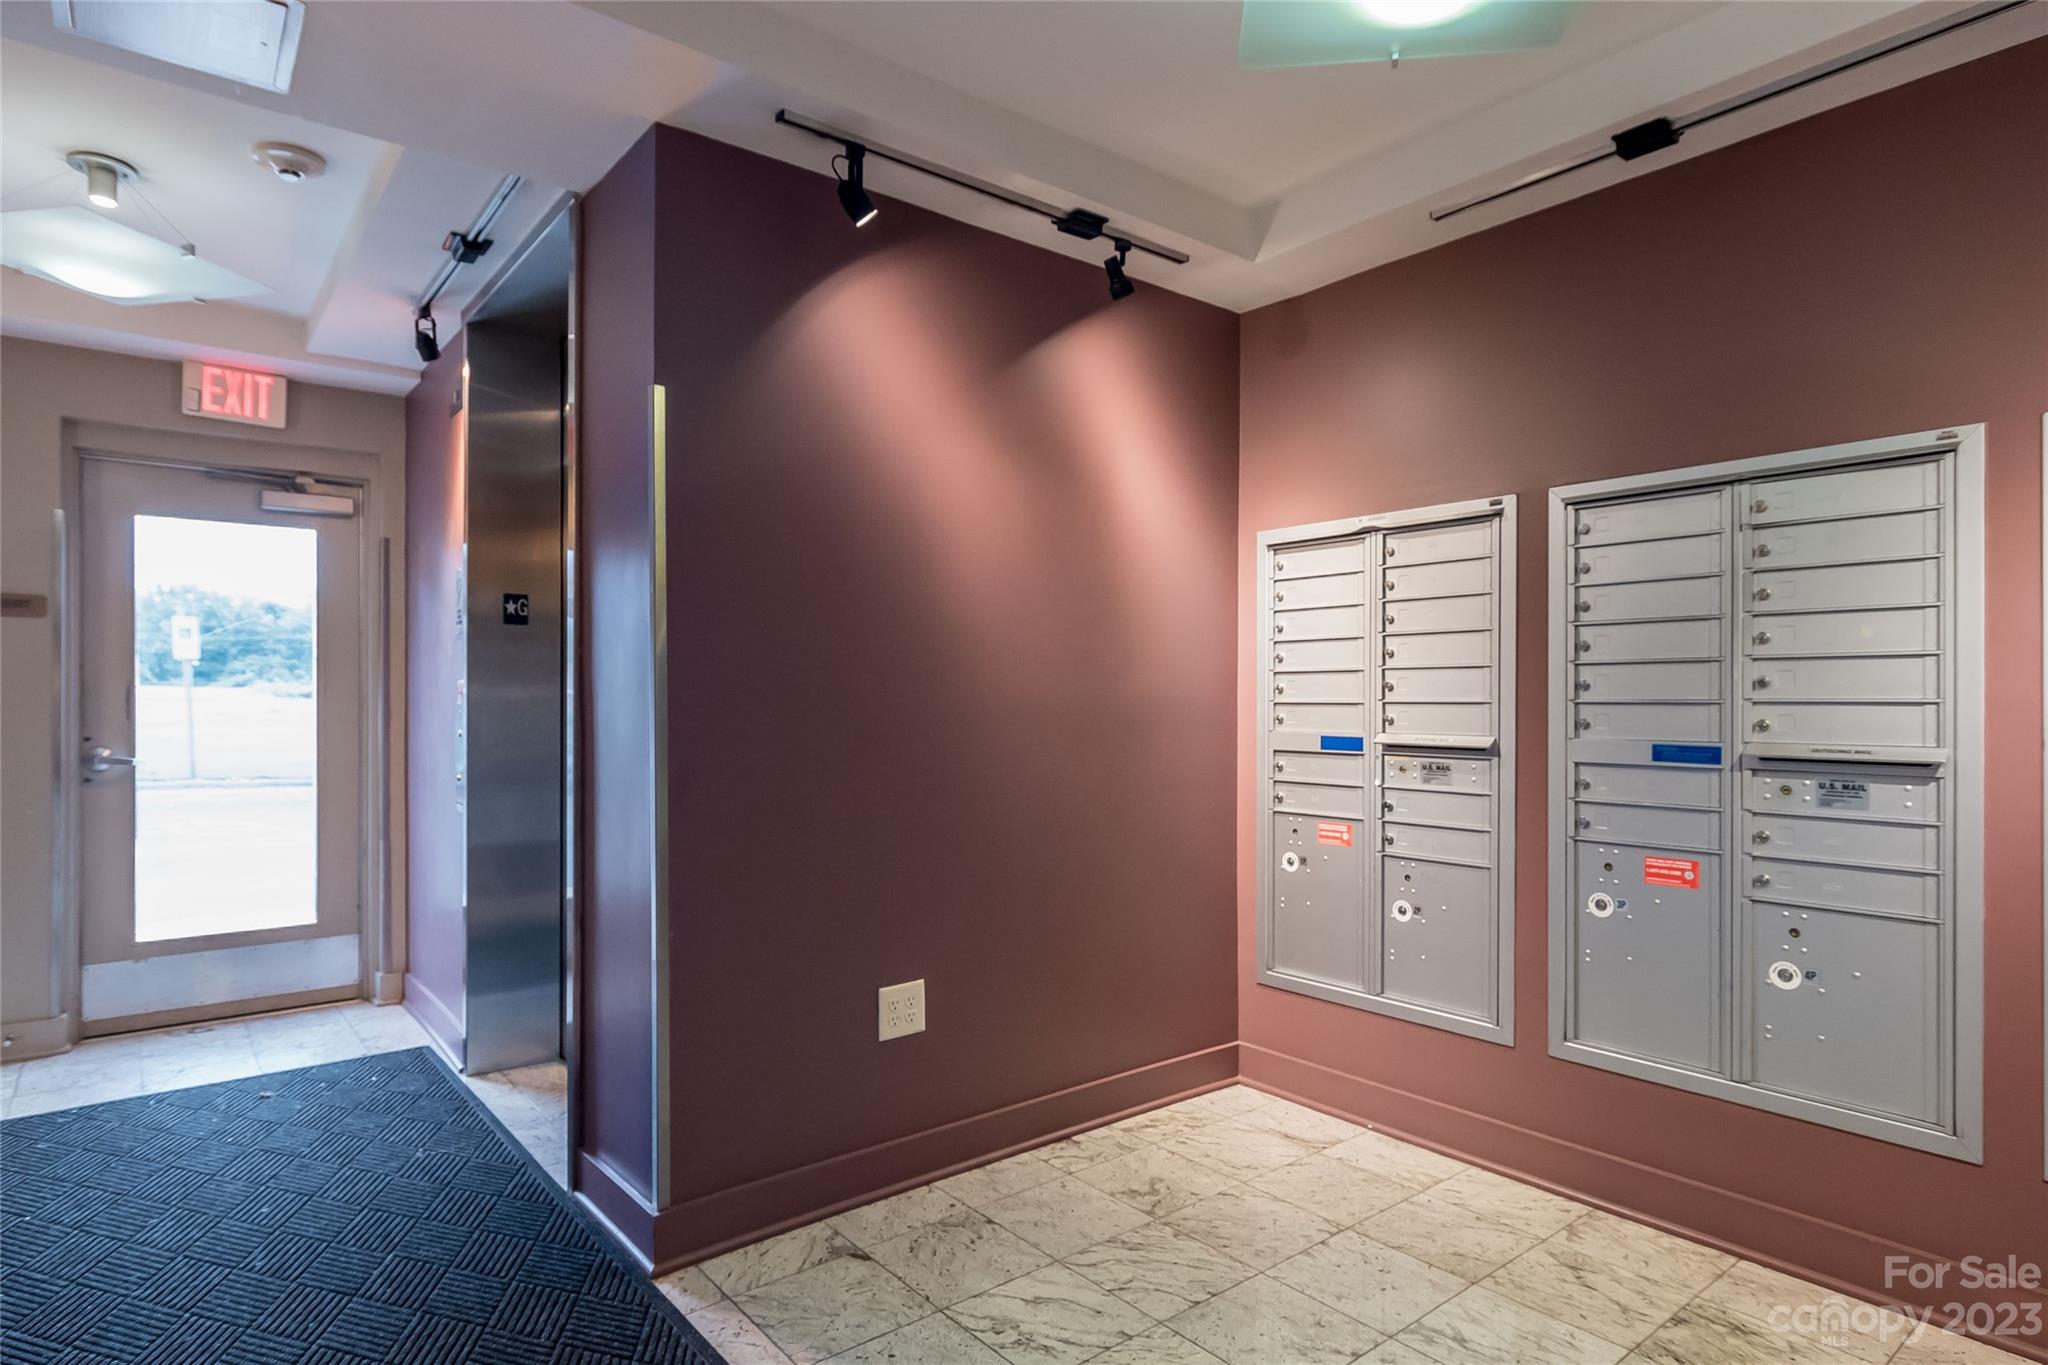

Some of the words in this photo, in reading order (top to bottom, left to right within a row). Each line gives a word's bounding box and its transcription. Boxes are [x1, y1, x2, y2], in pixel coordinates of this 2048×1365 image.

[201, 365, 276, 420] EXIT
[517, 598, 528, 616] G
[1818, 782, 1839, 791] U.S.
[1842, 783, 1867, 792] MAIL
